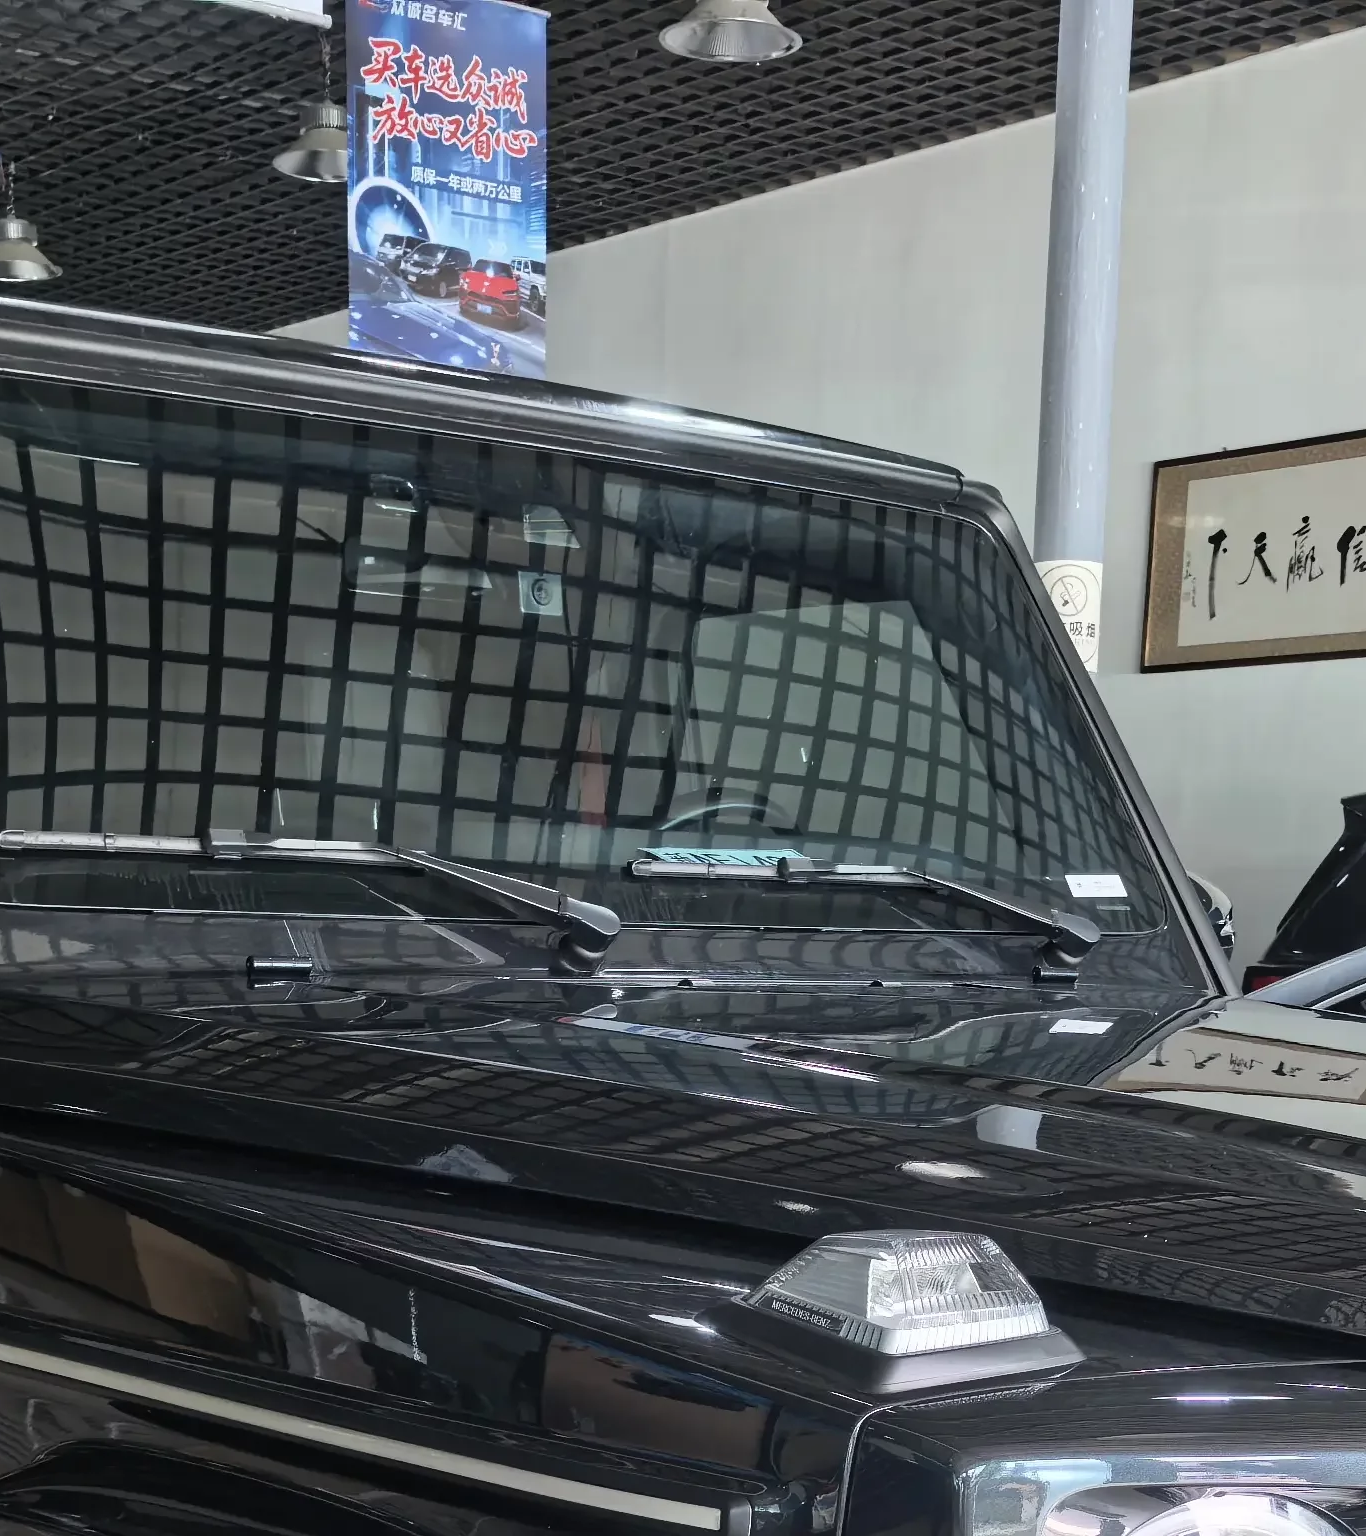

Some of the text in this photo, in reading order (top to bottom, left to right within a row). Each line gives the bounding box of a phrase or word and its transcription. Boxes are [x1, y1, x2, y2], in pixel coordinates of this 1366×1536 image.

[360, 36, 527, 123] 买车选众诚
[371, 94, 537, 162] 放心又省心
[411, 165, 523, 203] 质保一年或两万公里
[1063, 621, 1096, 638] 吸烟
[771, 1299, 831, 1329] MERCEDES-BENZ
